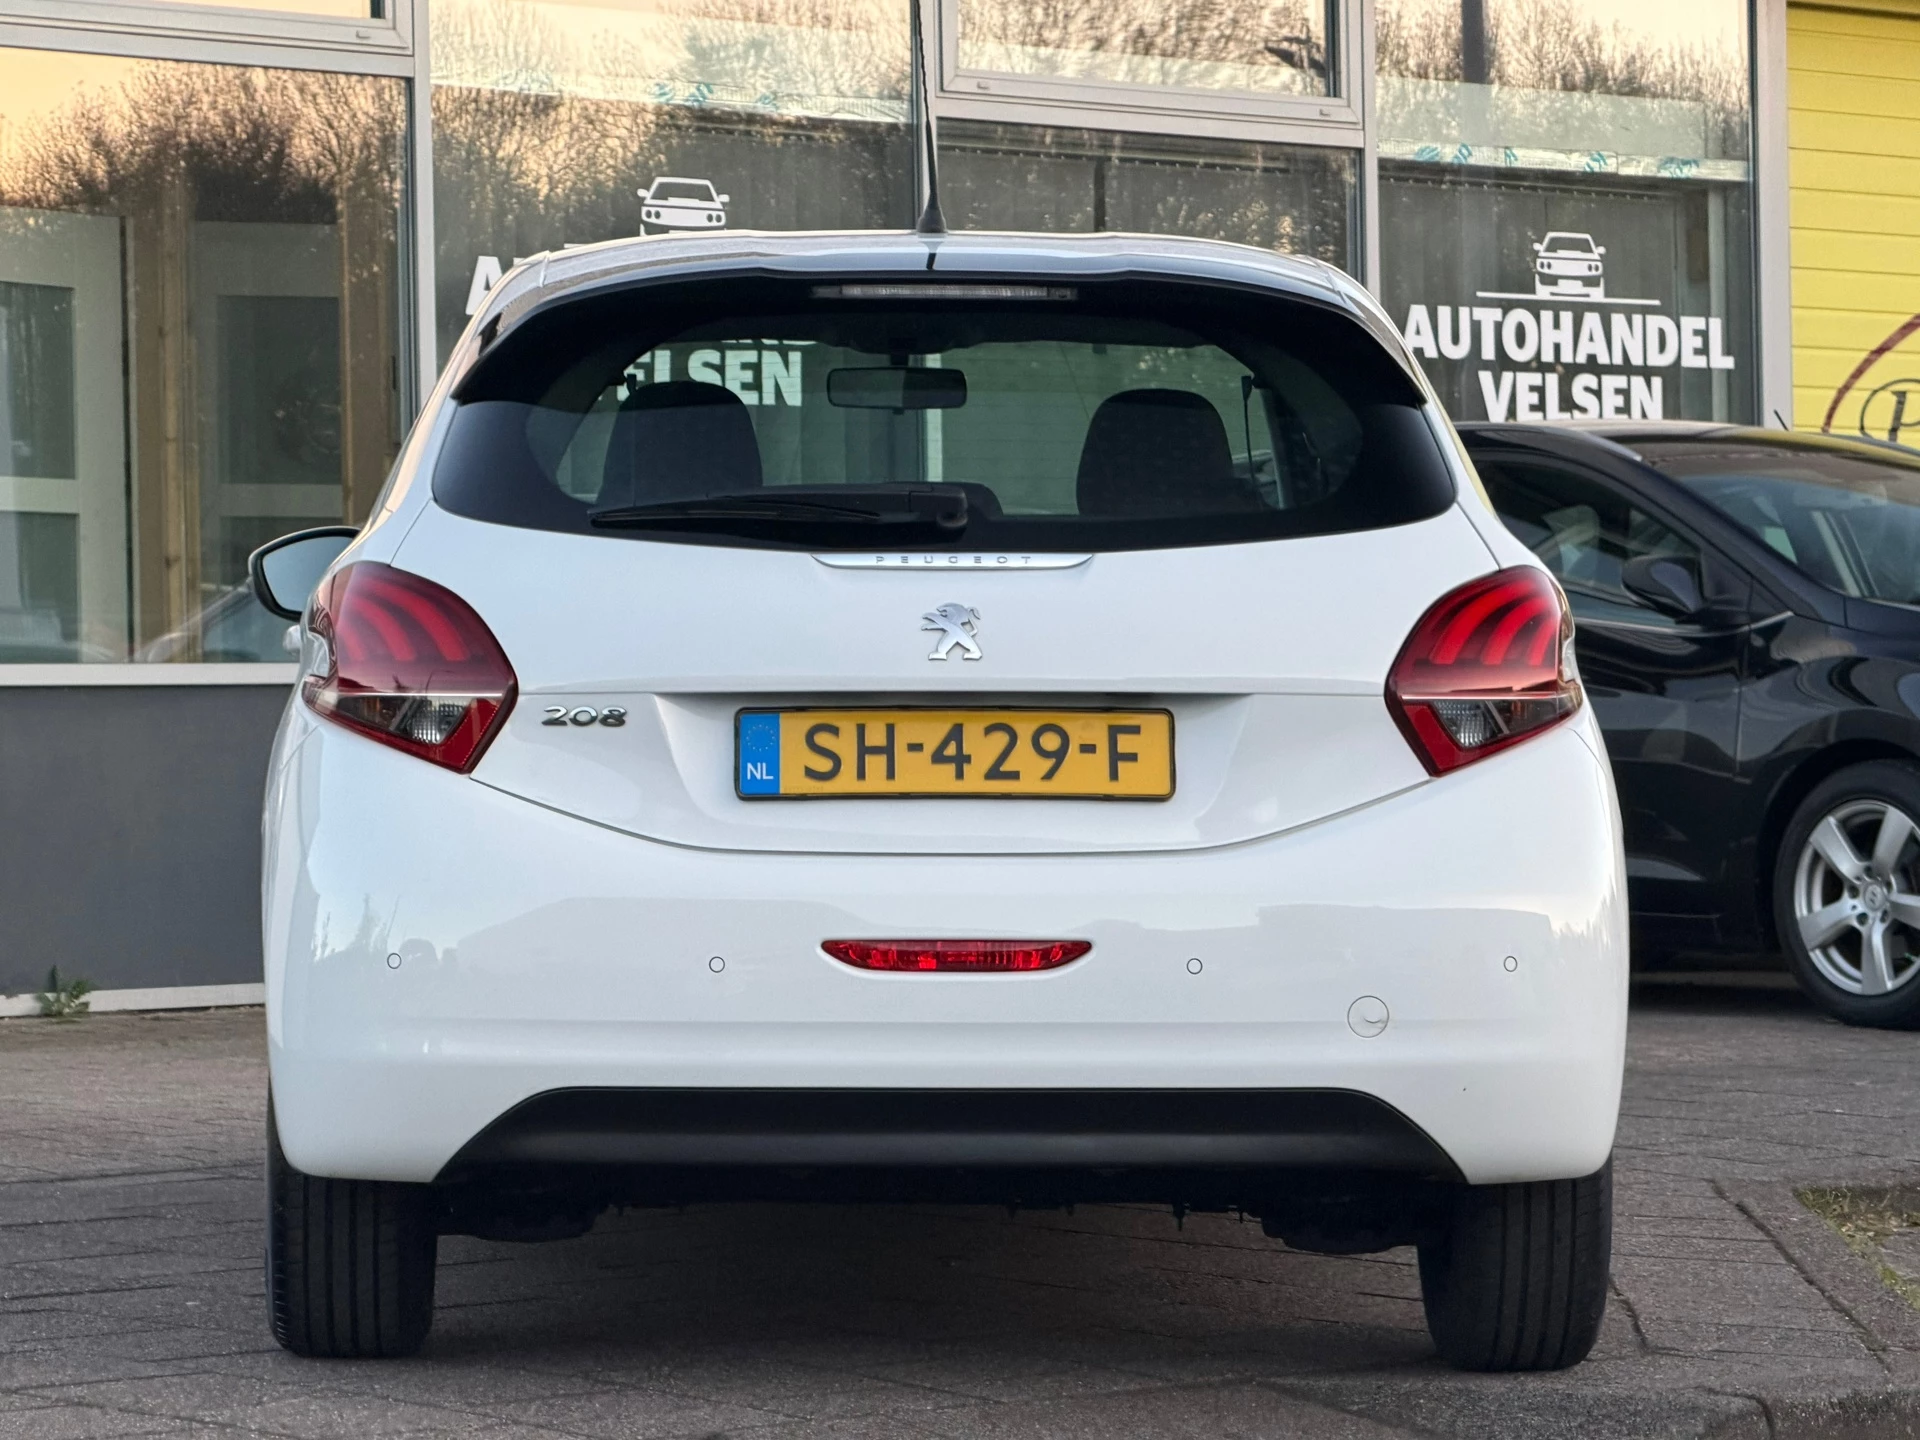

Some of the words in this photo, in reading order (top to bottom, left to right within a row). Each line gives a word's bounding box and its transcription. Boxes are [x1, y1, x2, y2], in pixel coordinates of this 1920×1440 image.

[1403, 304, 1735, 370] AUTOHANDEL
[614, 349, 802, 407] ELSEN
[1478, 369, 1663, 424] VELSEN
[875, 555, 1032, 565] PEUGEOT
[541, 705, 628, 728] 208
[746, 762, 774, 780] NL
[803, 722, 1142, 782] SH-429-F
